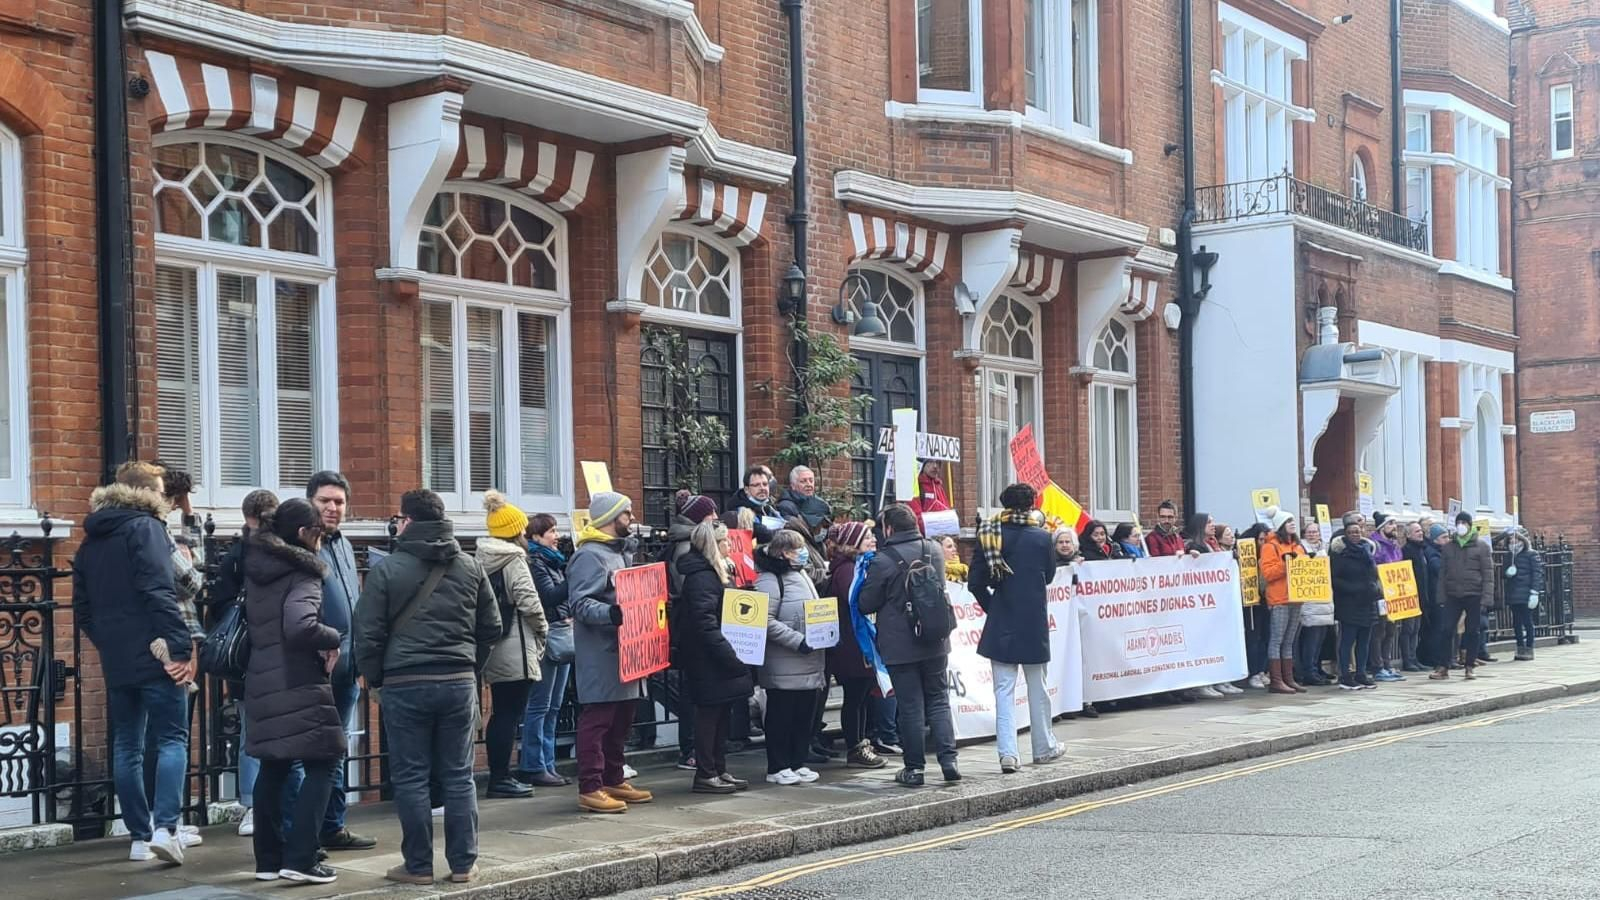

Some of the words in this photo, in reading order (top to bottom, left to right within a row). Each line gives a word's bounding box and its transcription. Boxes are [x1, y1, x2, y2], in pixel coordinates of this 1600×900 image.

[672, 286, 687, 309] 17
[1150, 575, 1157, 590] Y
[1158, 574, 1181, 589] BAJO
[1181, 568, 1231, 586] MÍNIMOS
[1098, 599, 1159, 620] CONDICIONES
[1160, 595, 1196, 612] DIGNAS
[1198, 592, 1217, 609] YA
